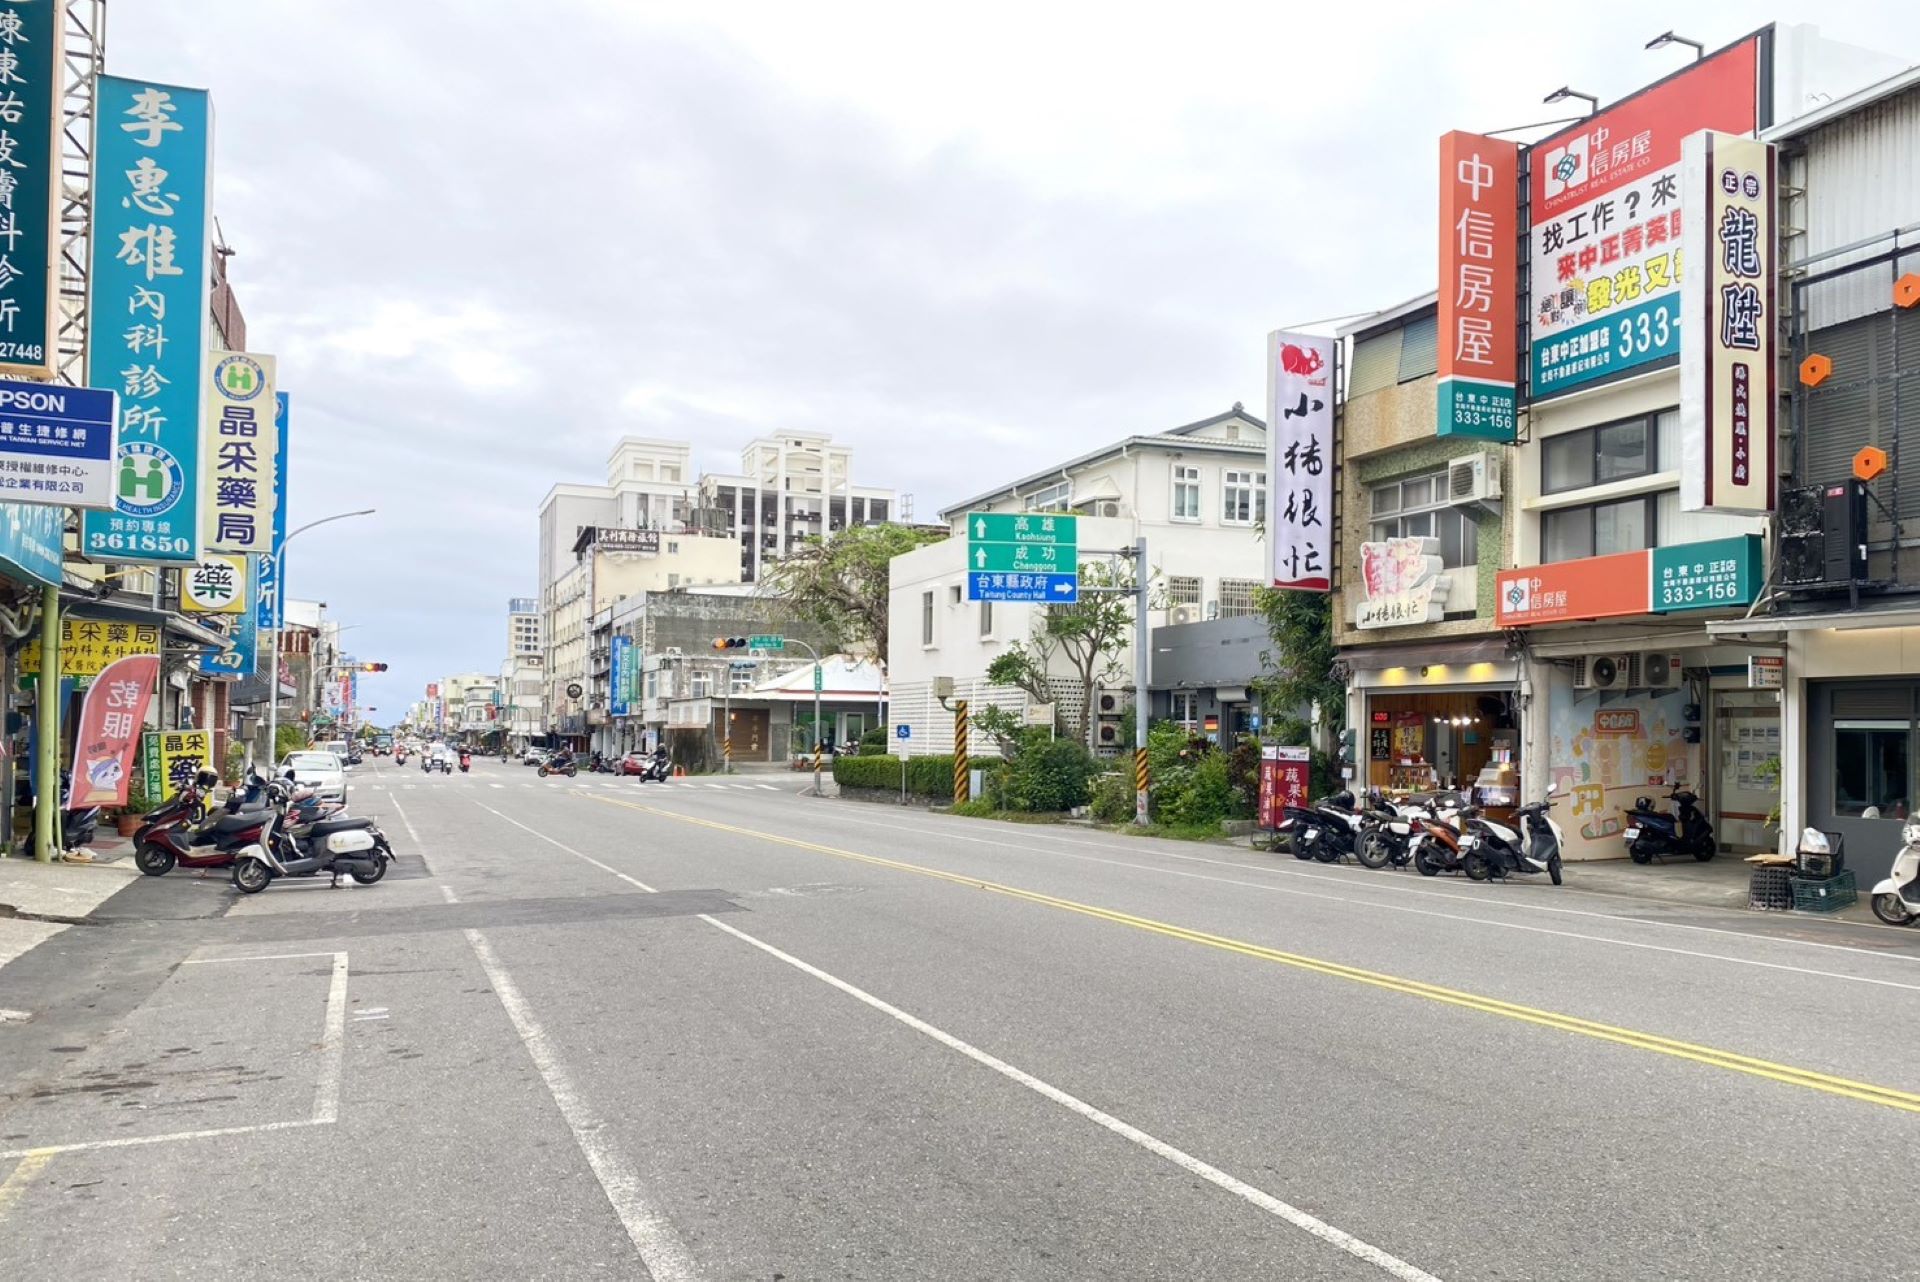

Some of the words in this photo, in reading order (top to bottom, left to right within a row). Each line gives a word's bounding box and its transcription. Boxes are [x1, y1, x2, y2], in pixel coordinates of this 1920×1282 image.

[1725, 174, 1758, 197] 正宗
[1456, 153, 1494, 365] 中信房屋
[1722, 206, 1762, 351] 龍陞
[1455, 410, 1512, 429] 333-156
[39, 439, 69, 447] SERVICE
[216, 406, 257, 545] 晶采藥局
[1015, 517, 1056, 531] 高雄
[91, 533, 190, 553] 361850
[1015, 533, 1056, 543] Kaohsiung
[1015, 546, 1056, 560] 成功
[977, 574, 1048, 590] 台東縣政府
[979, 590, 1006, 600] Taitung
[1006, 591, 1032, 600] County
[1033, 591, 1046, 599] Hall
[1664, 582, 1736, 603] 333-156
[166, 734, 205, 752] 晶采
